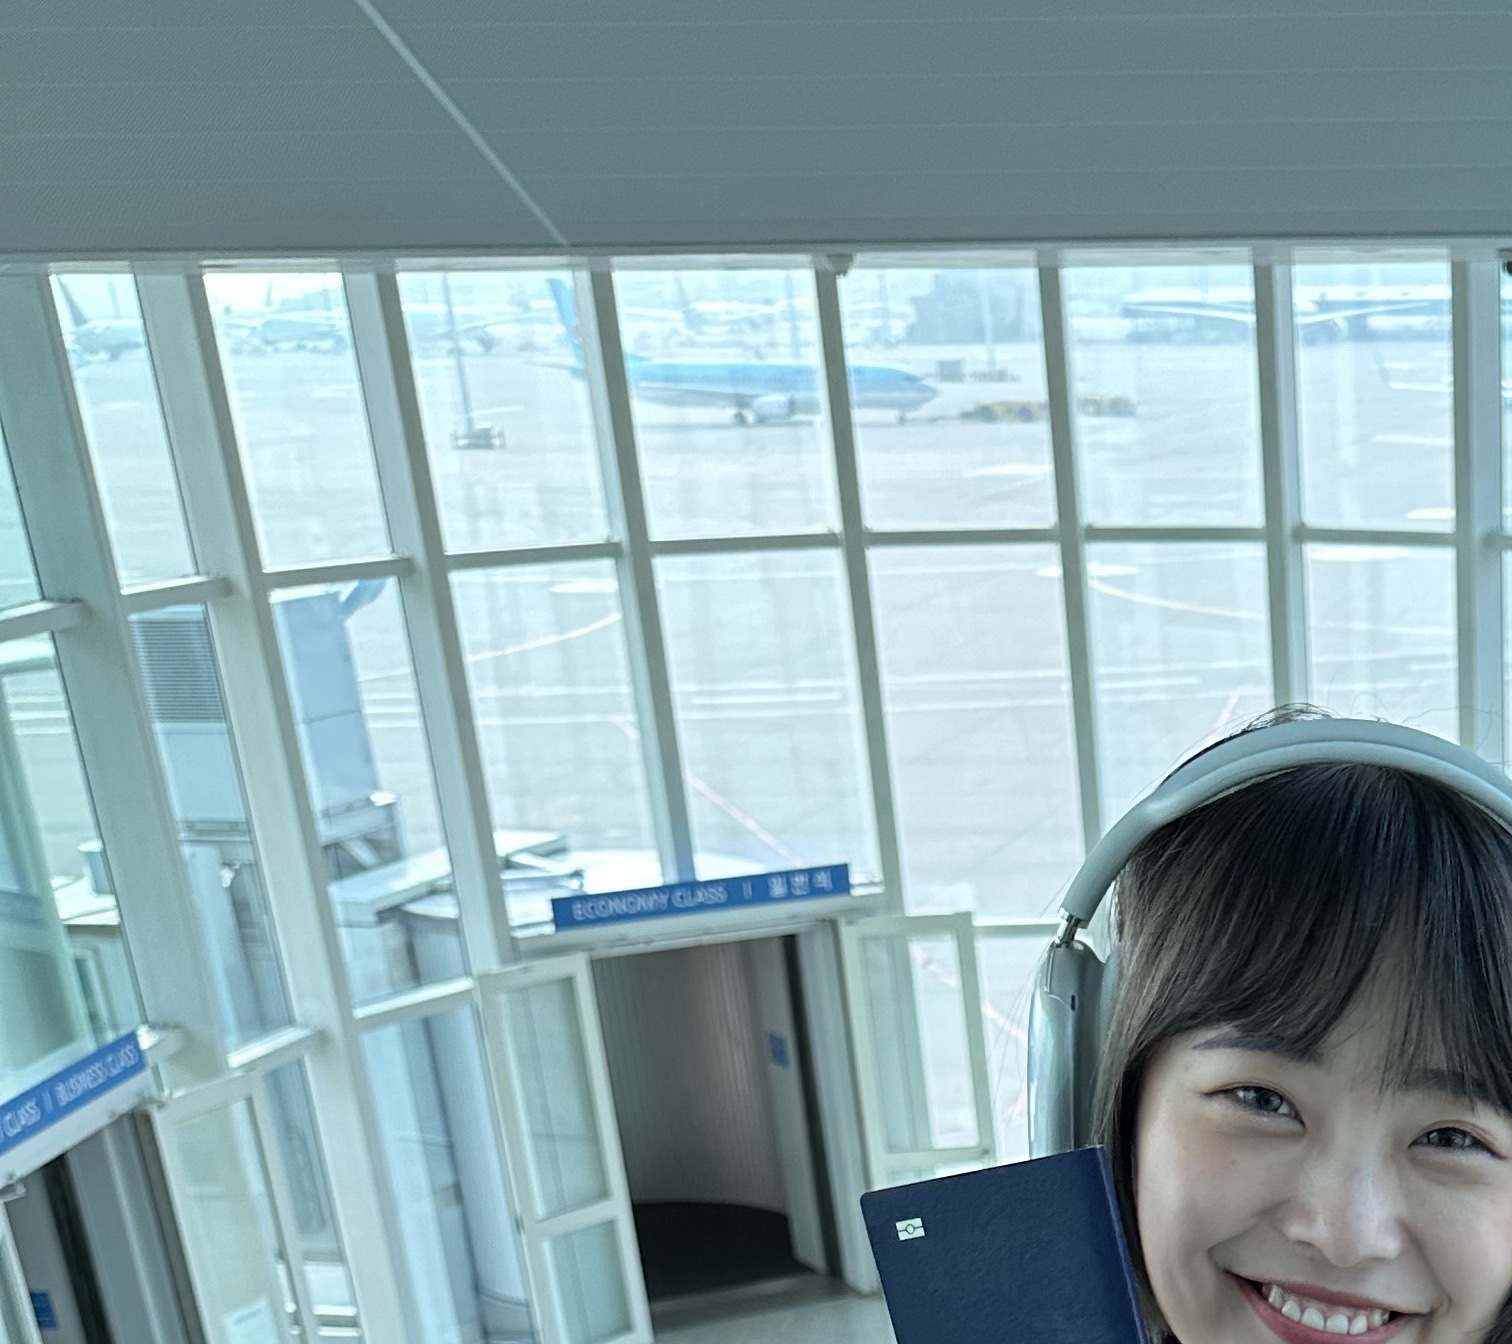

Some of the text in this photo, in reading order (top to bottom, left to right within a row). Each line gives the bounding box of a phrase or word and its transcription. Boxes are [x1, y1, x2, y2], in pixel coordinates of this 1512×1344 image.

[573, 884, 728, 921] ECONOMY CLASS
[55, 1044, 139, 1106] BUSINESS CLASS
[4, 1098, 41, 1137] CLASS
